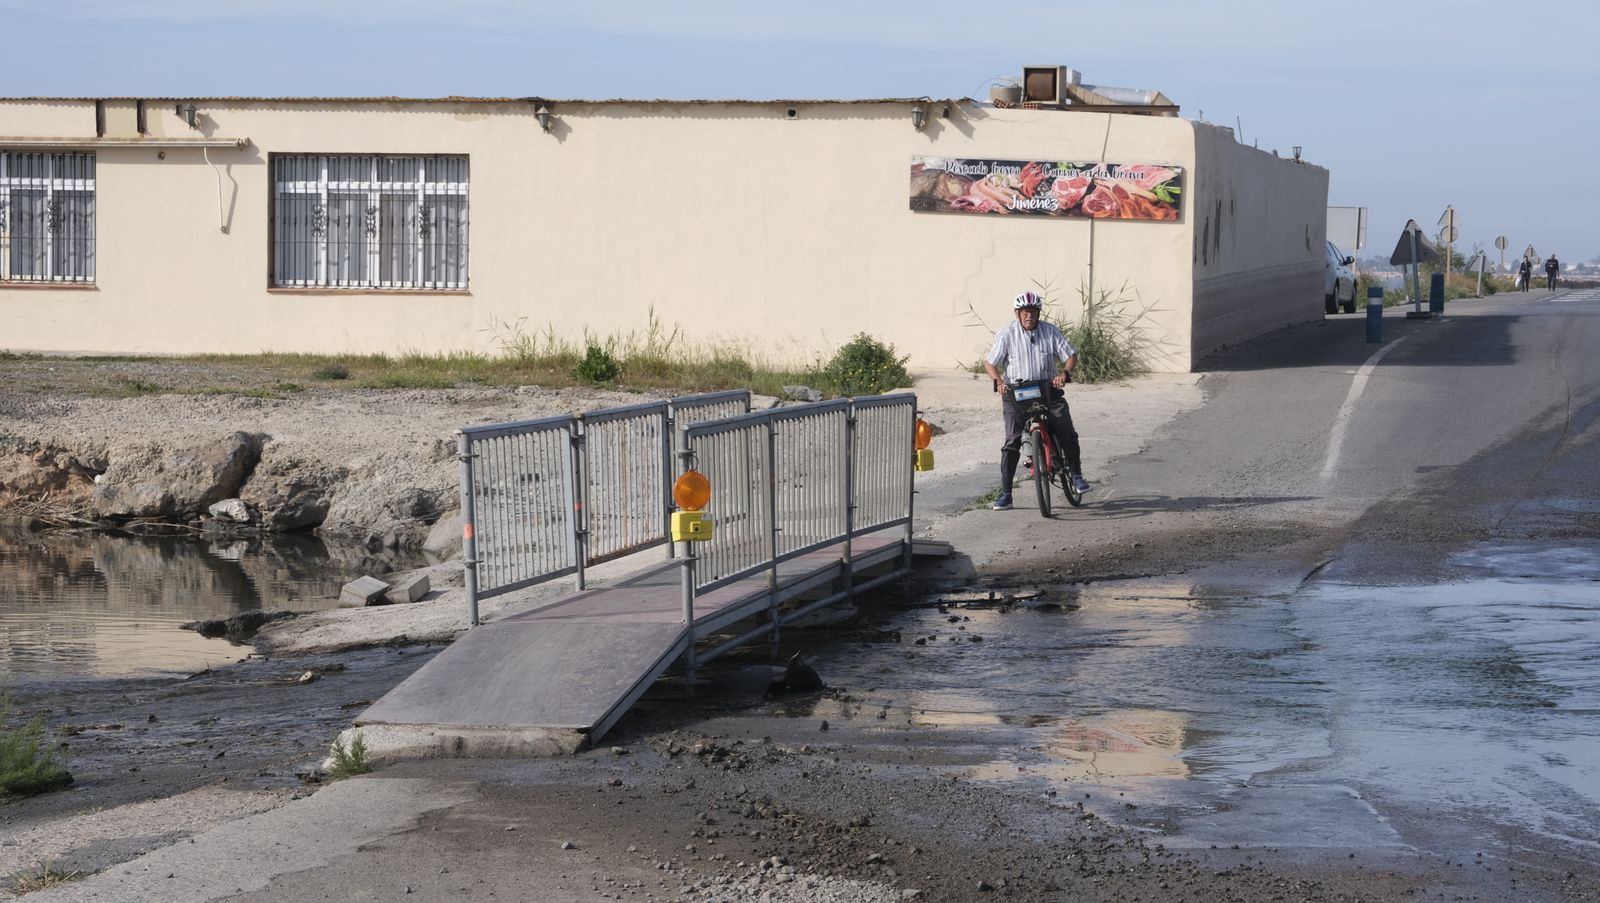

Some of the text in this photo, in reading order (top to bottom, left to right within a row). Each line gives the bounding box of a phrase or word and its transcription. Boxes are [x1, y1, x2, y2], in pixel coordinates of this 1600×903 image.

[944, 160, 989, 176] Pescado
[1041, 163, 1079, 178] Carnes
[1112, 166, 1144, 180] brasa
